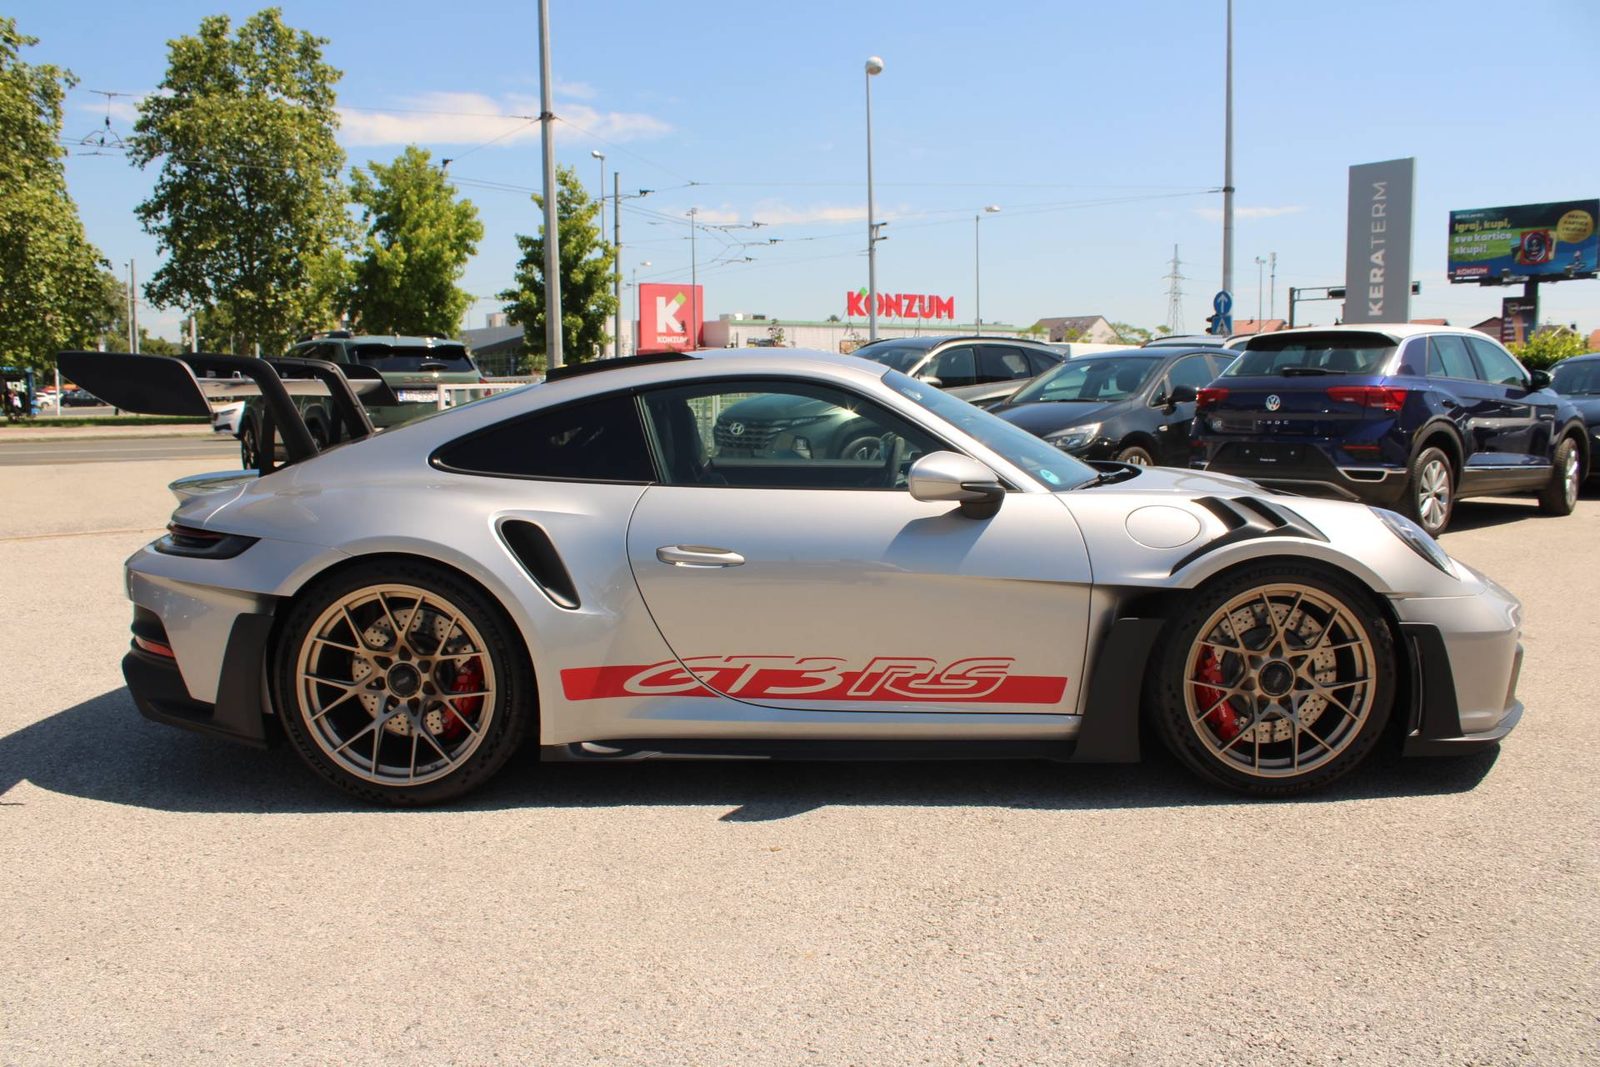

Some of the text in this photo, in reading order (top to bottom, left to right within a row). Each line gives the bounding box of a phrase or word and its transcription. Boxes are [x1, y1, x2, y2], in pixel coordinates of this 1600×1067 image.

[1473, 233, 1512, 242] kartice
[1483, 218, 1511, 230] kupi,
[1368, 181, 1387, 316] KERATERM
[656, 292, 687, 333] K
[847, 287, 954, 319] KONZUM
